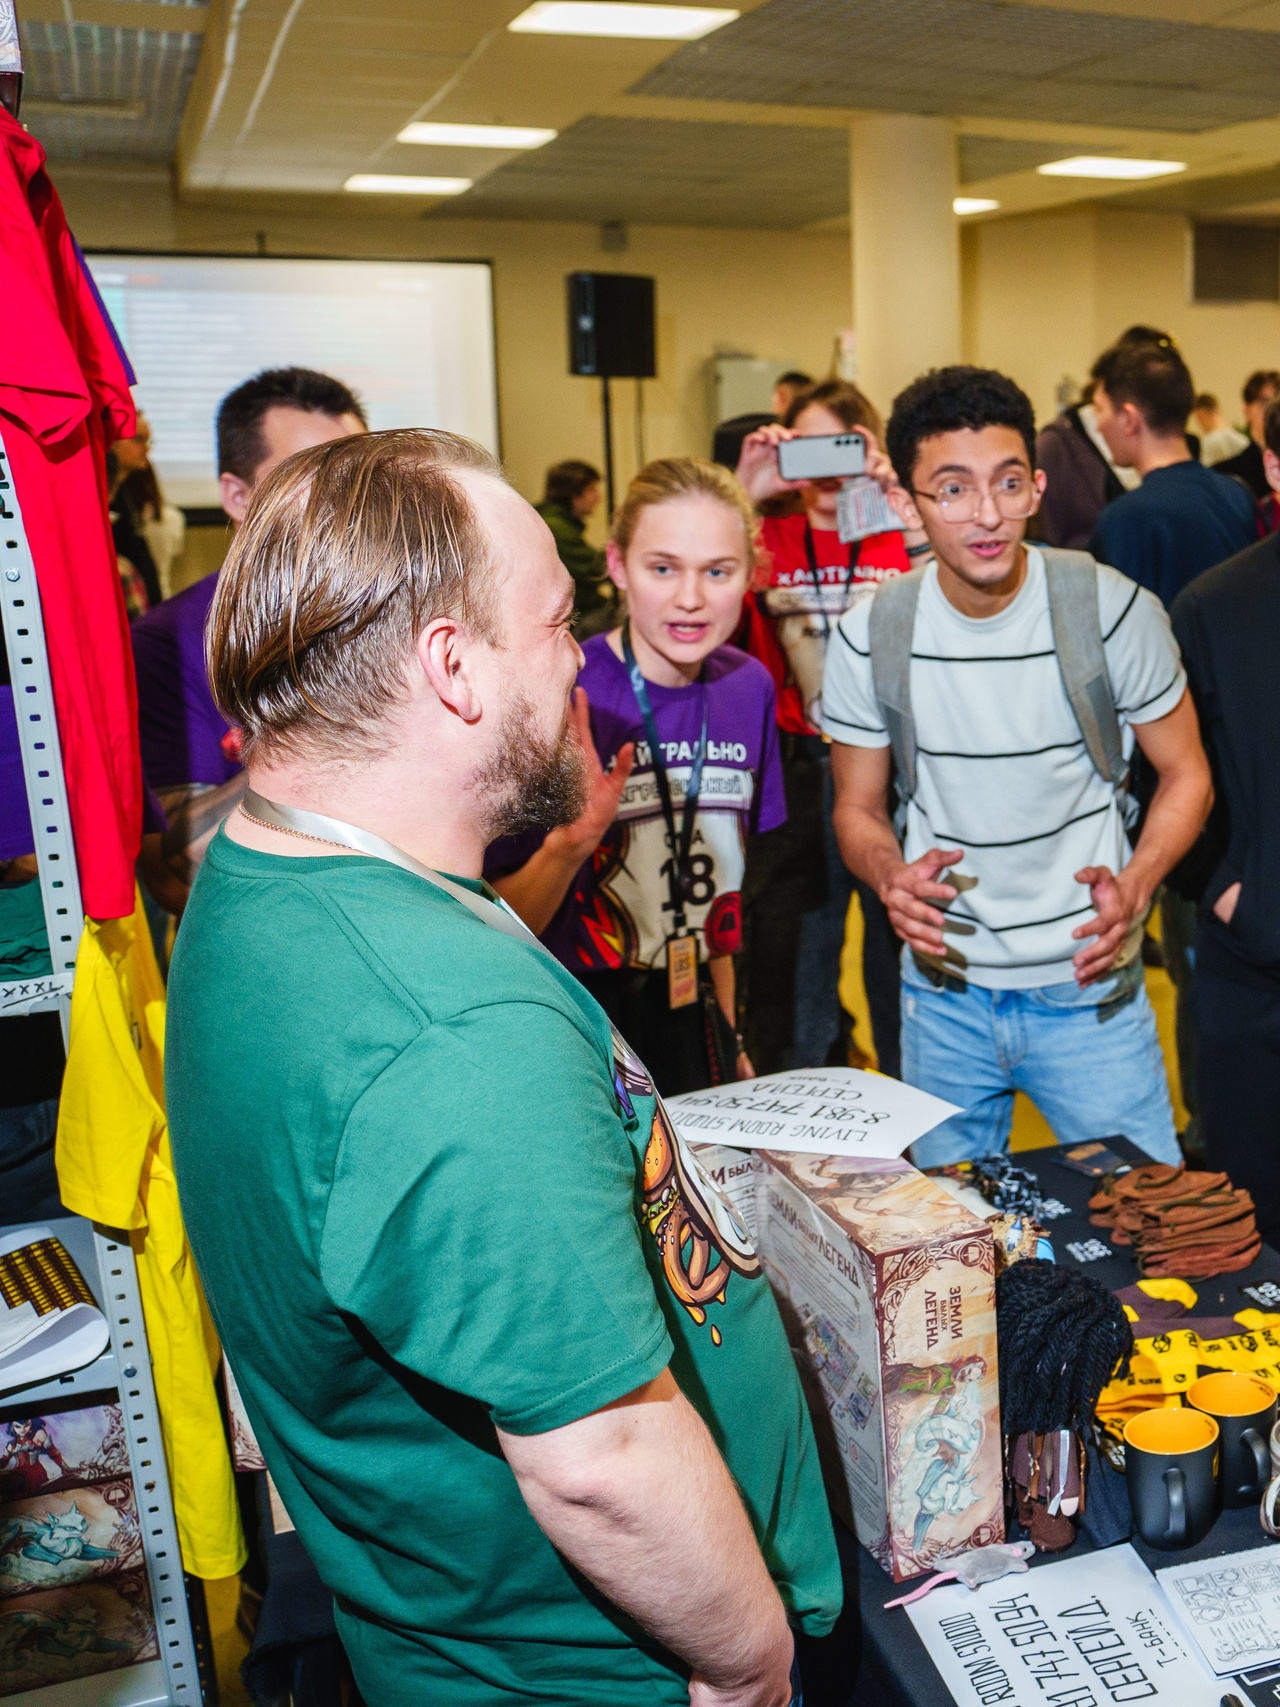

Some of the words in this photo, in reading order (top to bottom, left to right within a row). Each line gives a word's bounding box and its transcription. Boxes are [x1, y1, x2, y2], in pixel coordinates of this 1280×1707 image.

[728, 1119, 785, 1137] ROOM
[789, 1124, 869, 1142] LIVING
[809, 1104, 866, 1122] 981
[818, 1235, 862, 1289] ЛЕГЕНД
[924, 1288, 939, 1351] ЛЕГЕНД
[940, 1299, 948, 1332] БЫЛЫХ
[949, 1285, 963, 1340] ЗЕМЛИ
[988, 1593, 1040, 1622] 94
[939, 1612, 992, 1658] STUDIO
[1002, 1619, 1058, 1648] 50
[963, 1655, 1016, 1706] ROOM
[1021, 1649, 1080, 1690] 747
[1064, 1620, 1159, 1703] СЕРГЕЙ
